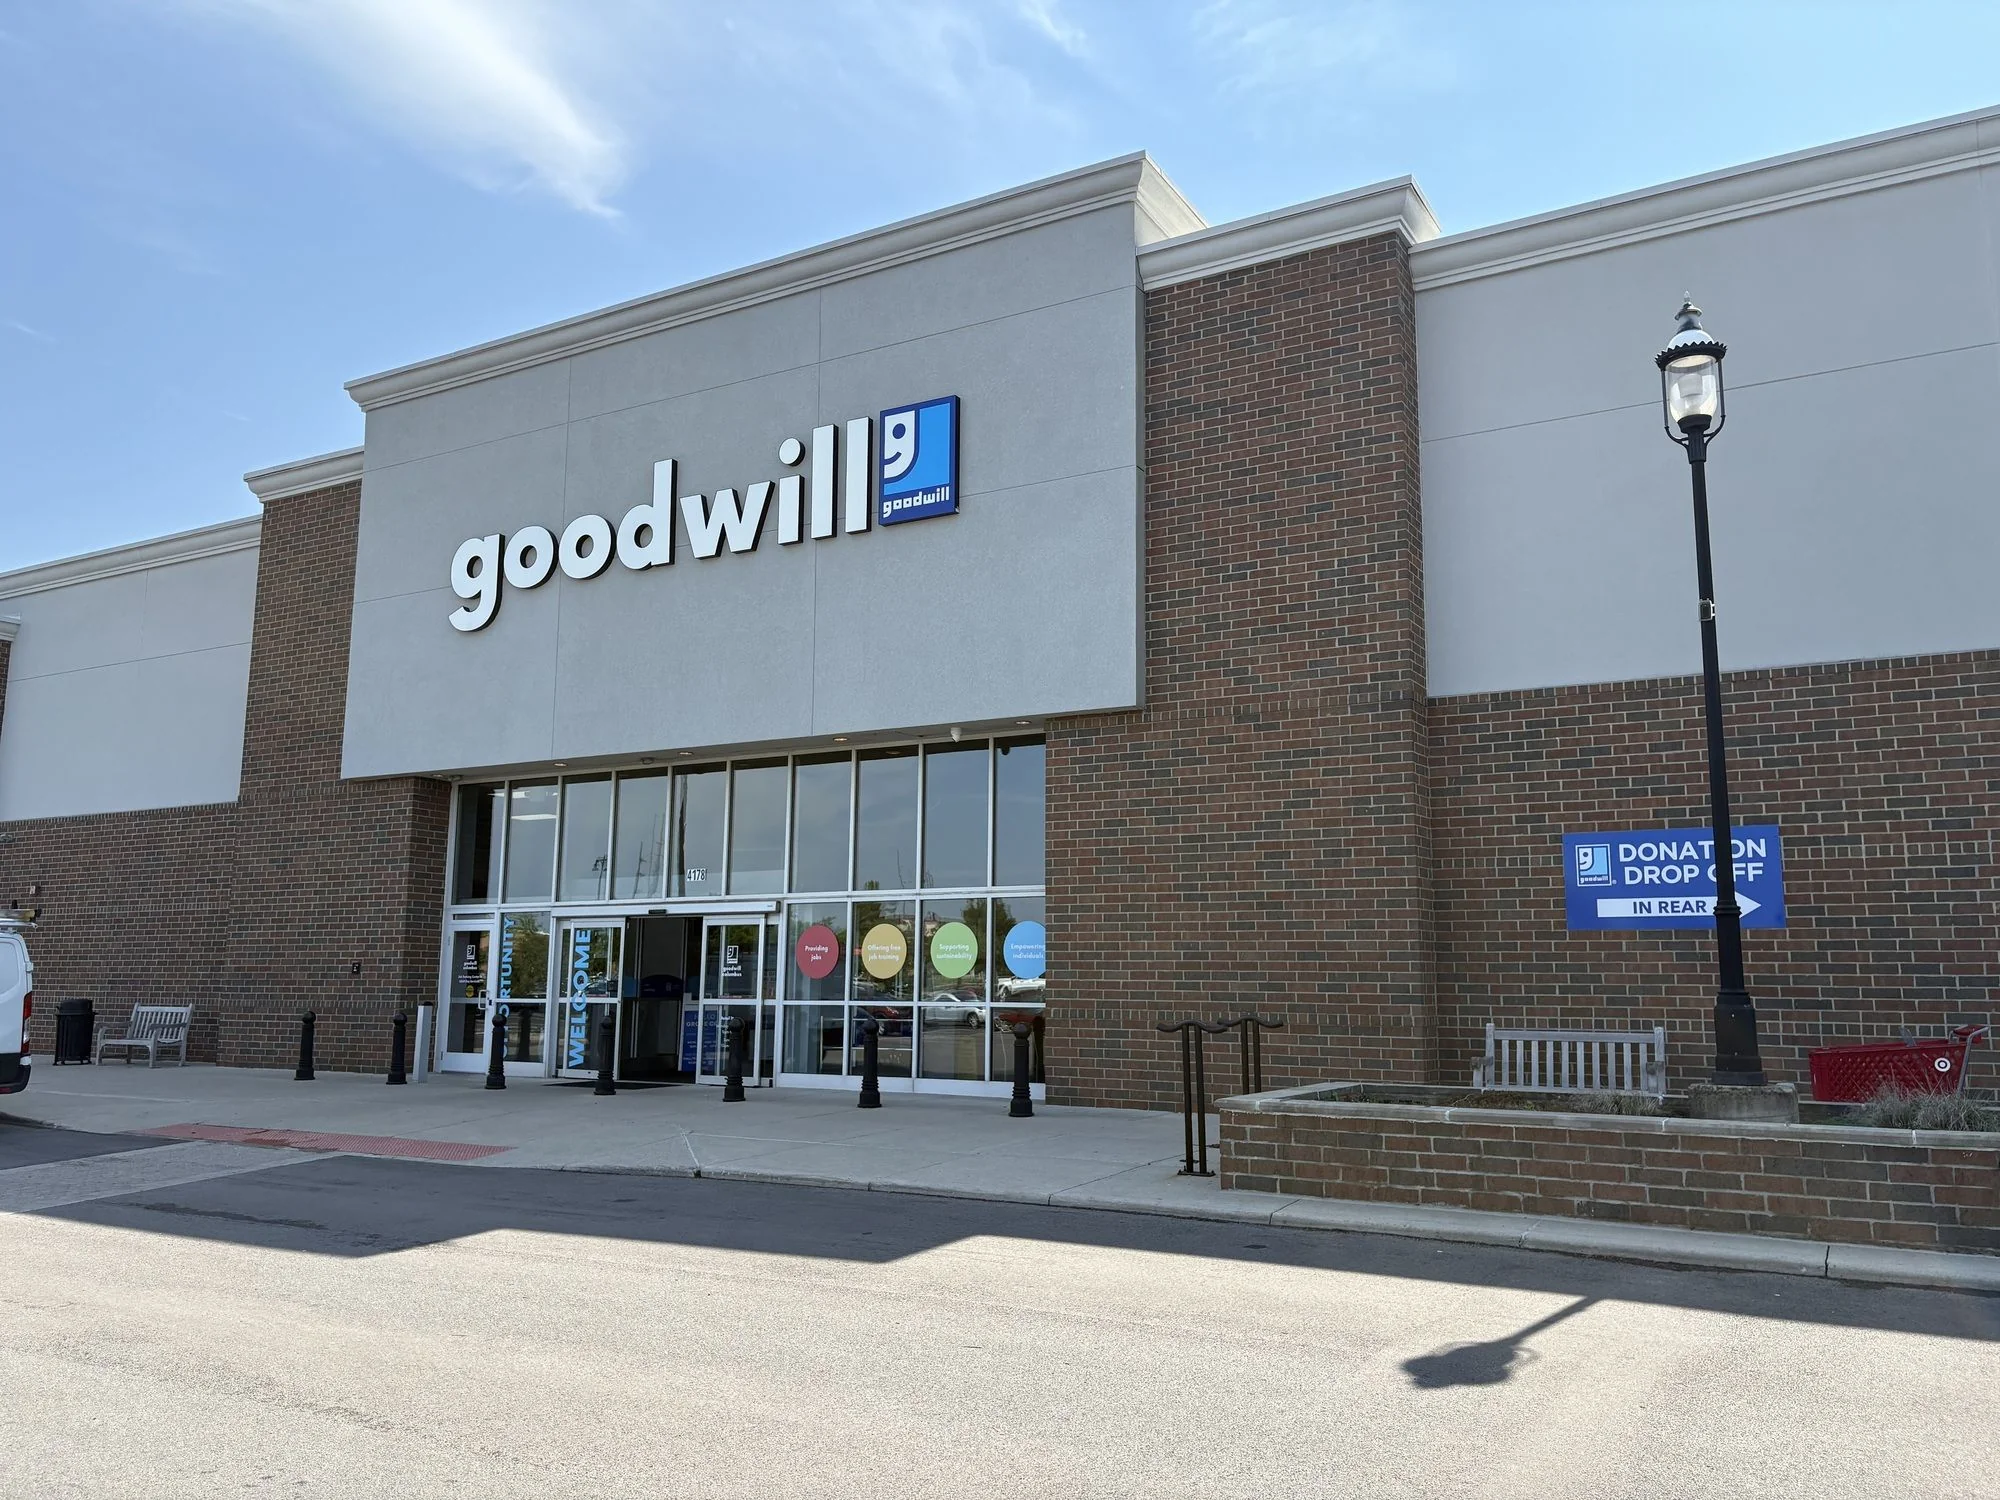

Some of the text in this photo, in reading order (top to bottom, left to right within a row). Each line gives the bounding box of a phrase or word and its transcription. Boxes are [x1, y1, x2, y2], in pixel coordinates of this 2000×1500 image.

[883, 486, 950, 518] goodwill
[448, 416, 872, 632] goodwill
[1619, 838, 1767, 862] DONATON
[687, 868, 706, 881] 4178
[1624, 864, 1699, 885] DROP
[1633, 900, 1707, 914] IN REAR
[804, 944, 829, 953] Providing
[867, 944, 890, 953] Offering
[940, 943, 970, 952] Supporting
[810, 953, 822, 962] jobs
[499, 917, 515, 1058] ORTUNITY
[568, 929, 592, 1067] WELCOME
